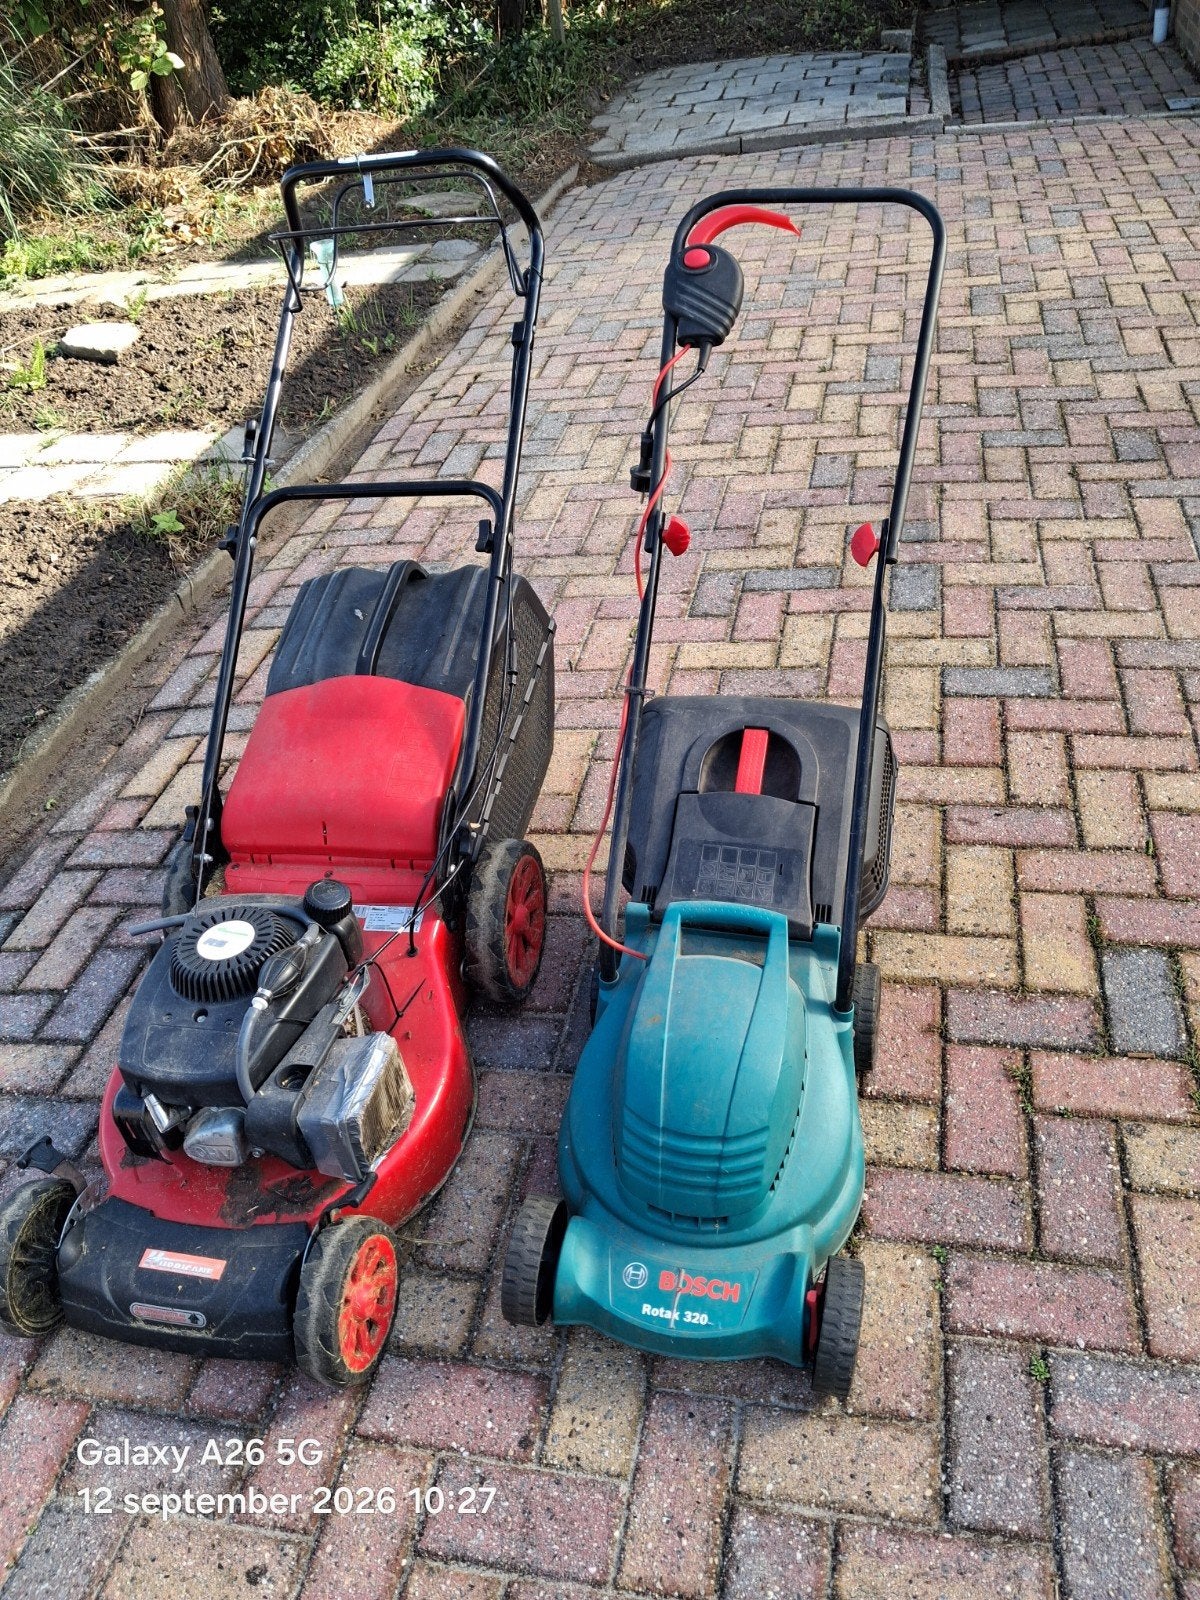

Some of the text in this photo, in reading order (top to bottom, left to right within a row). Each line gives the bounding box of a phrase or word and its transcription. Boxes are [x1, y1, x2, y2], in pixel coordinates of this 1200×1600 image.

[659, 1270, 741, 1302] BOSCH
[642, 1304, 708, 1325] Rotak 320
